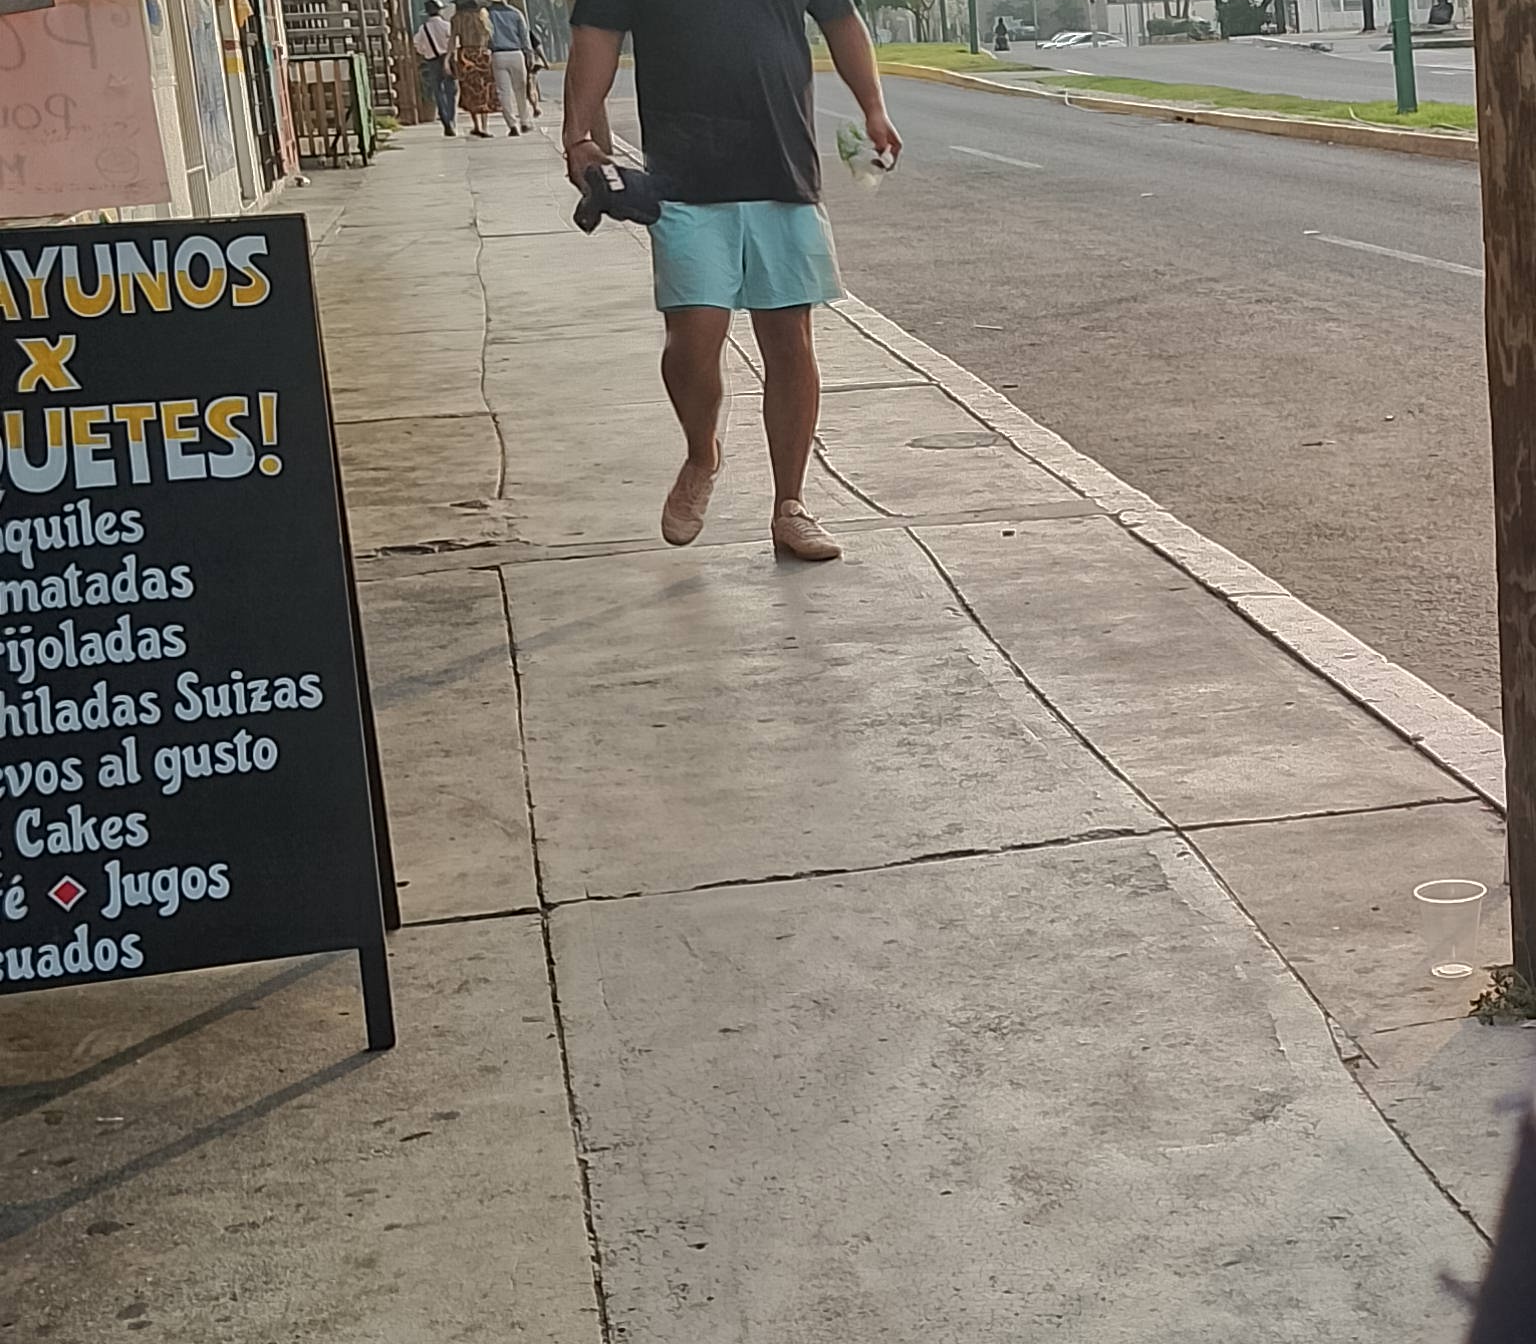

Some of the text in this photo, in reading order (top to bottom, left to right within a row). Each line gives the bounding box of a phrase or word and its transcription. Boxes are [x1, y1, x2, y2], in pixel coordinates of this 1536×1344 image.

[0, 392, 282, 494] UETES!
[0, 499, 144, 569] quiles
[0, 614, 187, 683] ijoladas
[174, 671, 323, 721] Suizas
[0, 729, 278, 798] vos al gusto
[15, 804, 149, 857] Cakes
[0, 860, 230, 920] é Jugos
[0, 924, 143, 981] uados
